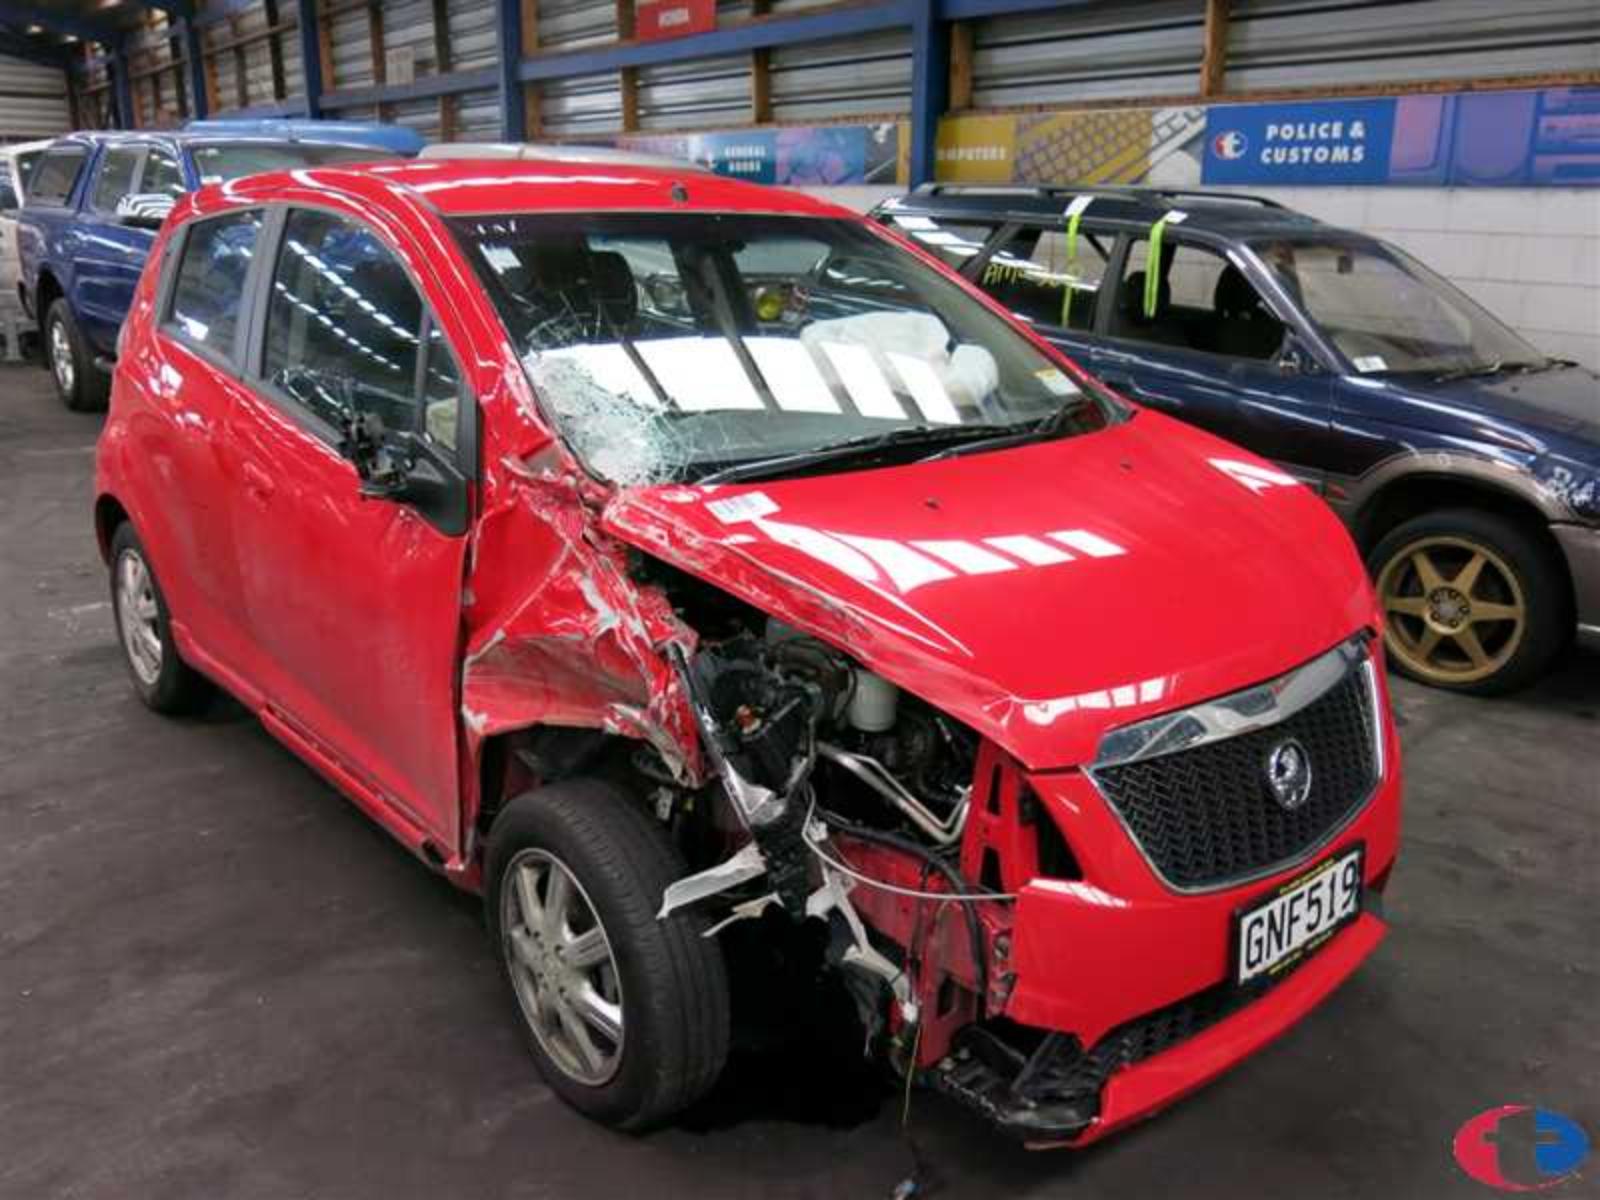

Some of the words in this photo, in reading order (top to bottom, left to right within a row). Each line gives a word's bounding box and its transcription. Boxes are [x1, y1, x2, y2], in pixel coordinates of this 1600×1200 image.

[1265, 121, 1343, 141] POLICE
[1349, 119, 1366, 139] &
[1260, 144, 1365, 164] CUSTOMS
[1246, 860, 1358, 970] GNF519
